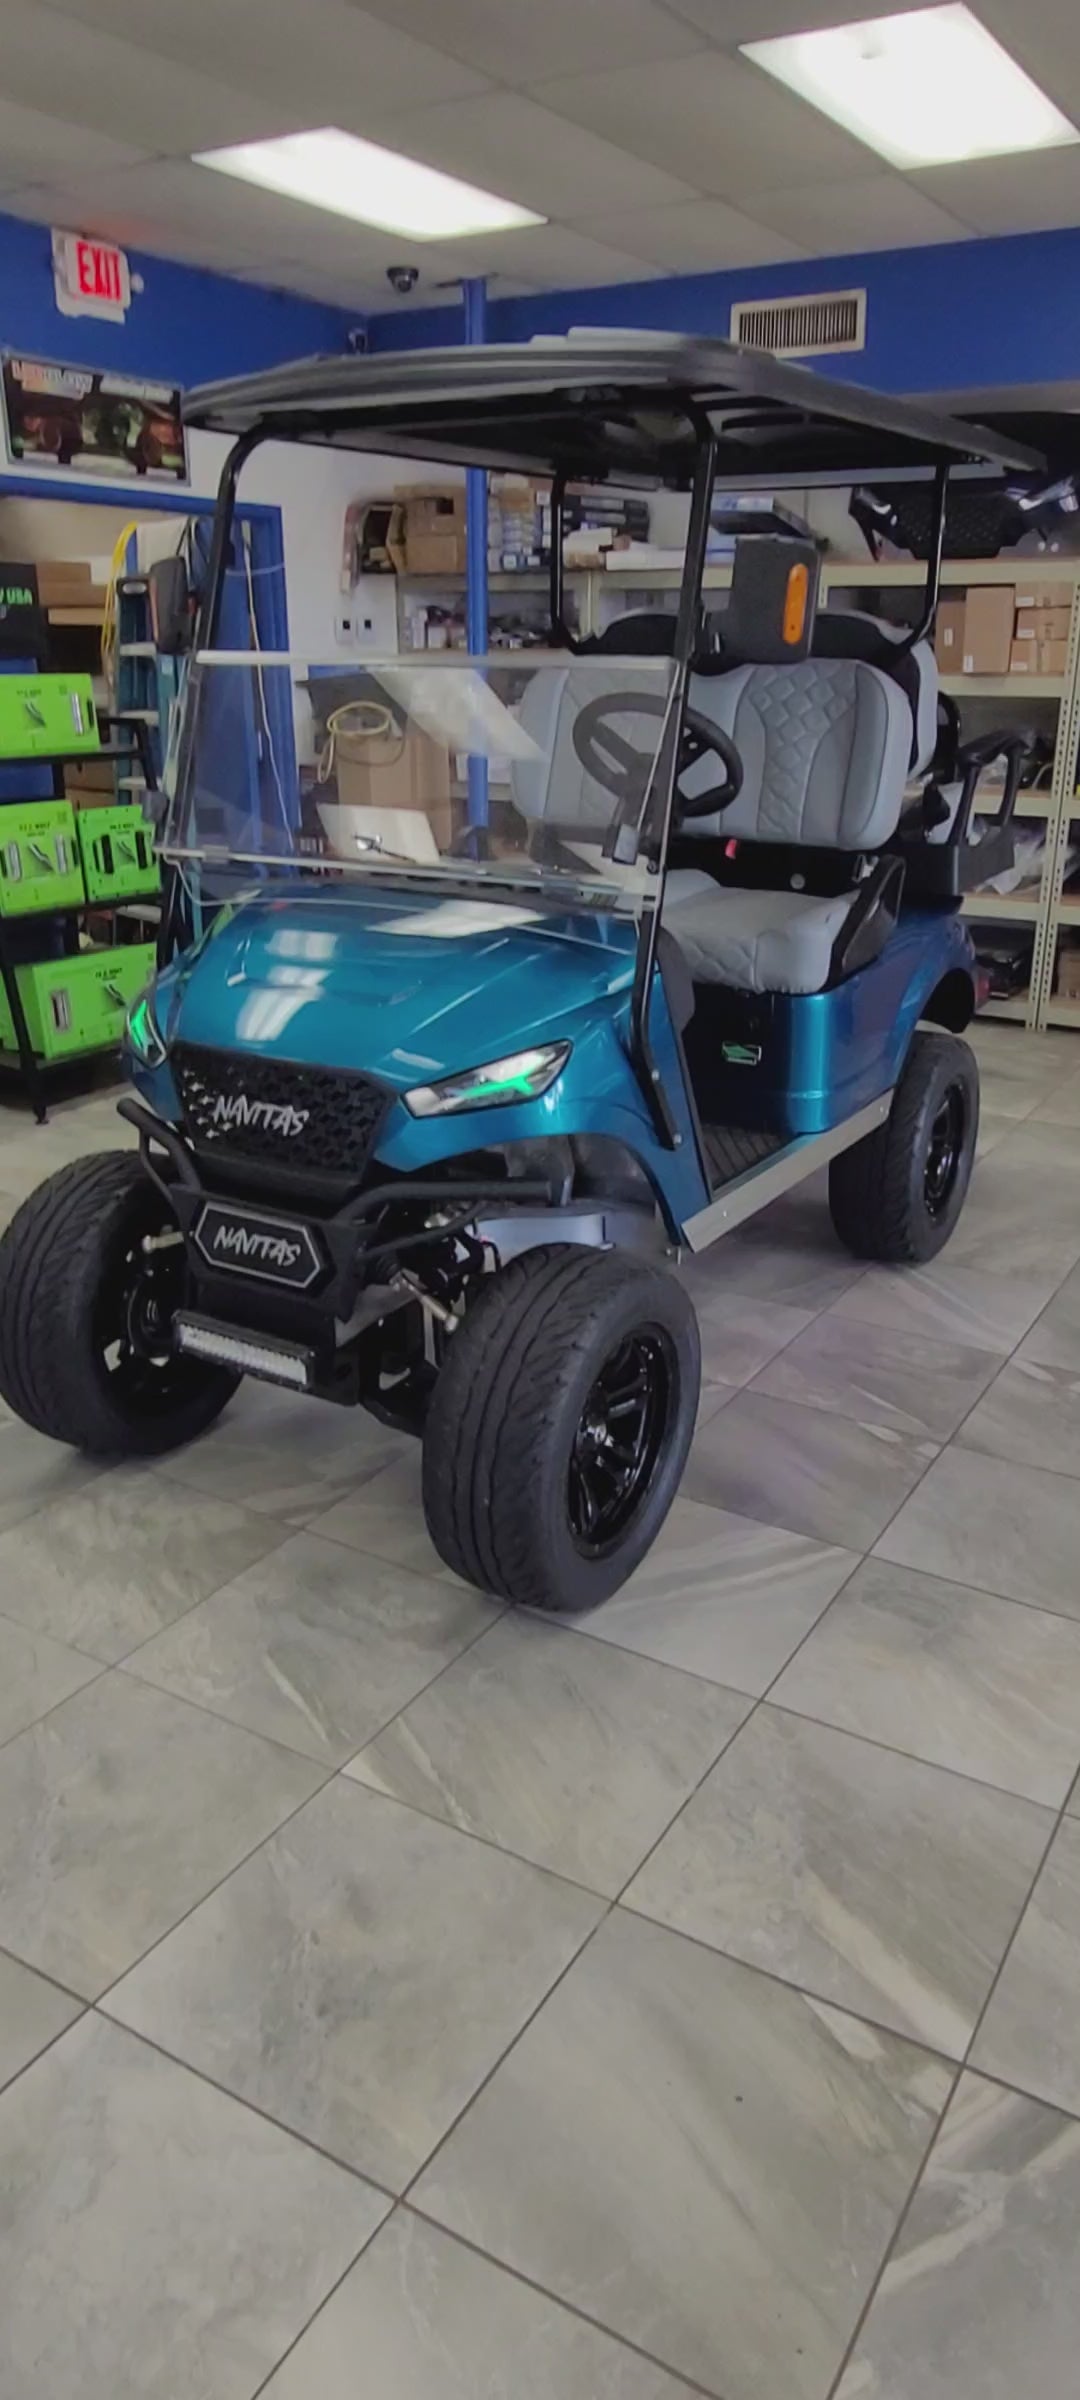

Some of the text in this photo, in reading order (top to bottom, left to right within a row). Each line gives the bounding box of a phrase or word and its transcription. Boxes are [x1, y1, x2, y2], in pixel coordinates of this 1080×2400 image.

[75, 240, 122, 301] EXIT
[212, 1094, 310, 1136] NAVITAS
[213, 1225, 301, 1267] NAVITAS
